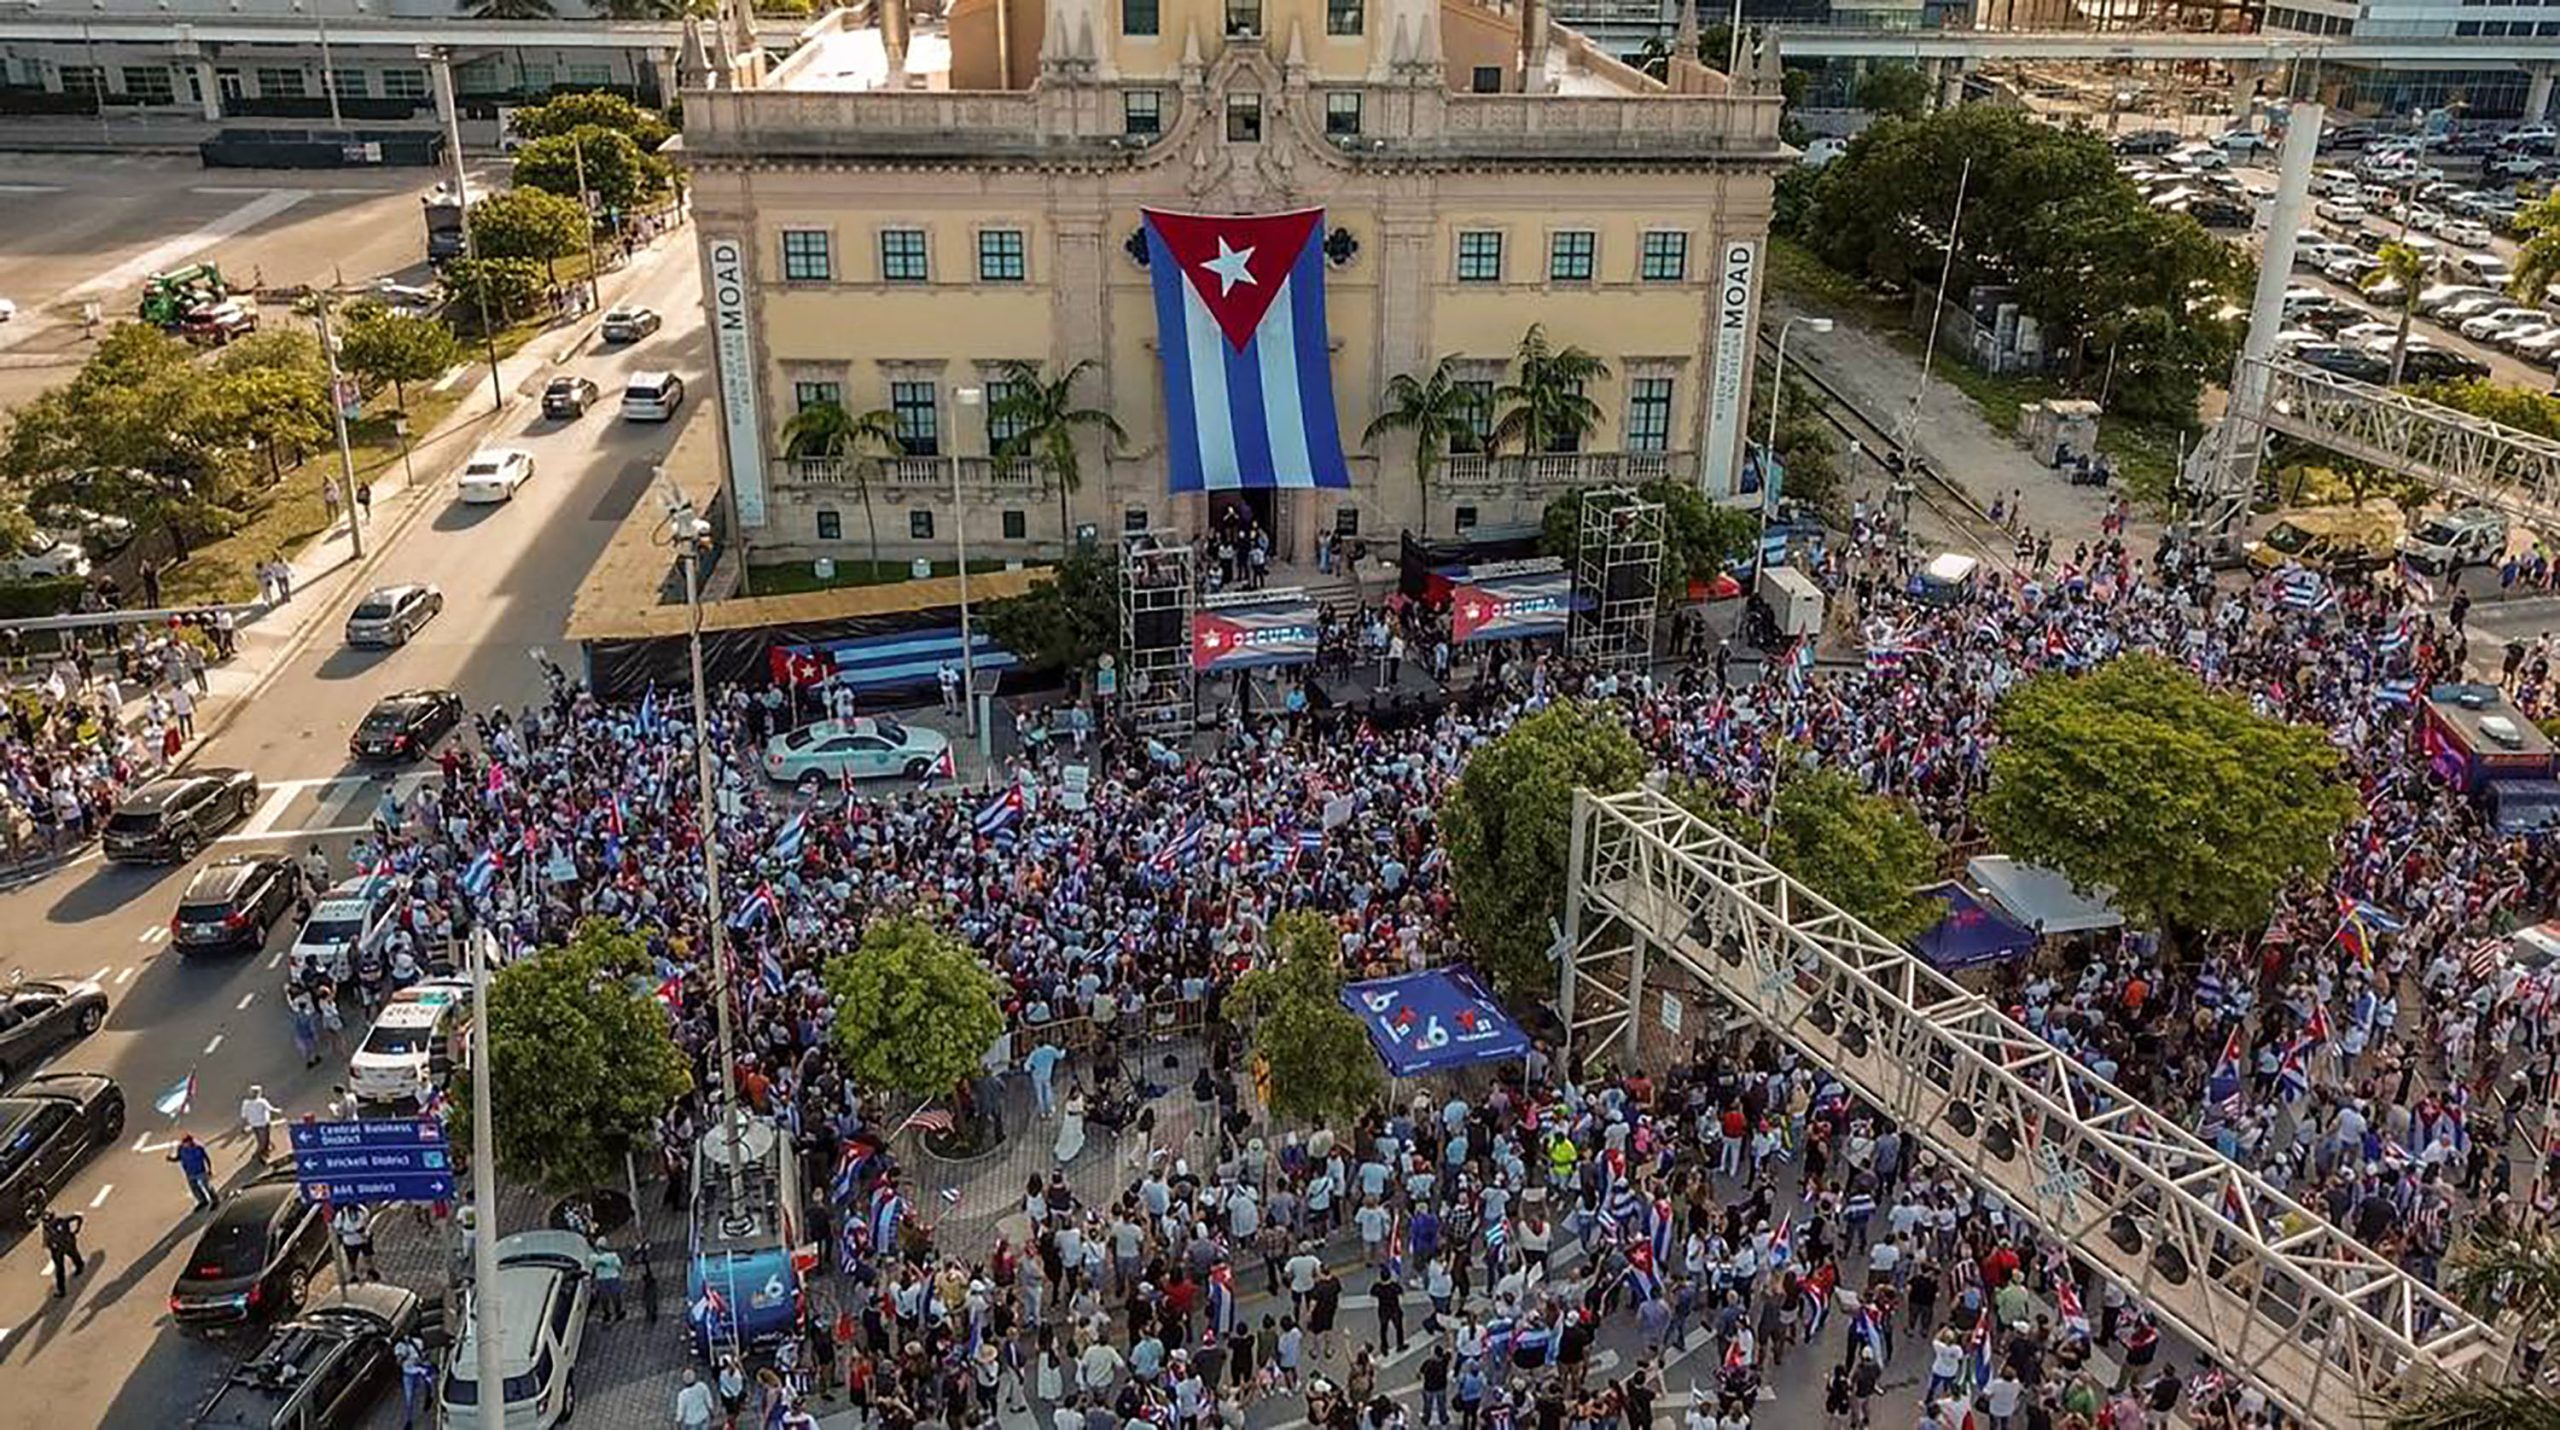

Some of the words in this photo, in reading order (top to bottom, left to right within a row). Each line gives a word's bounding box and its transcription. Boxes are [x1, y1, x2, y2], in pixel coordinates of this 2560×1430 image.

[715, 246, 744, 330] MOAD
[1724, 247, 1750, 329] MOAD
[1427, 1015, 1449, 1046] 6
[319, 1124, 362, 1135] Central
[364, 1123, 413, 1133] Business
[321, 1135, 362, 1146] District
[326, 1157, 368, 1168] Brickell
[372, 1155, 410, 1166] District
[357, 1182, 396, 1193] District
[765, 1274, 784, 1298] 6
